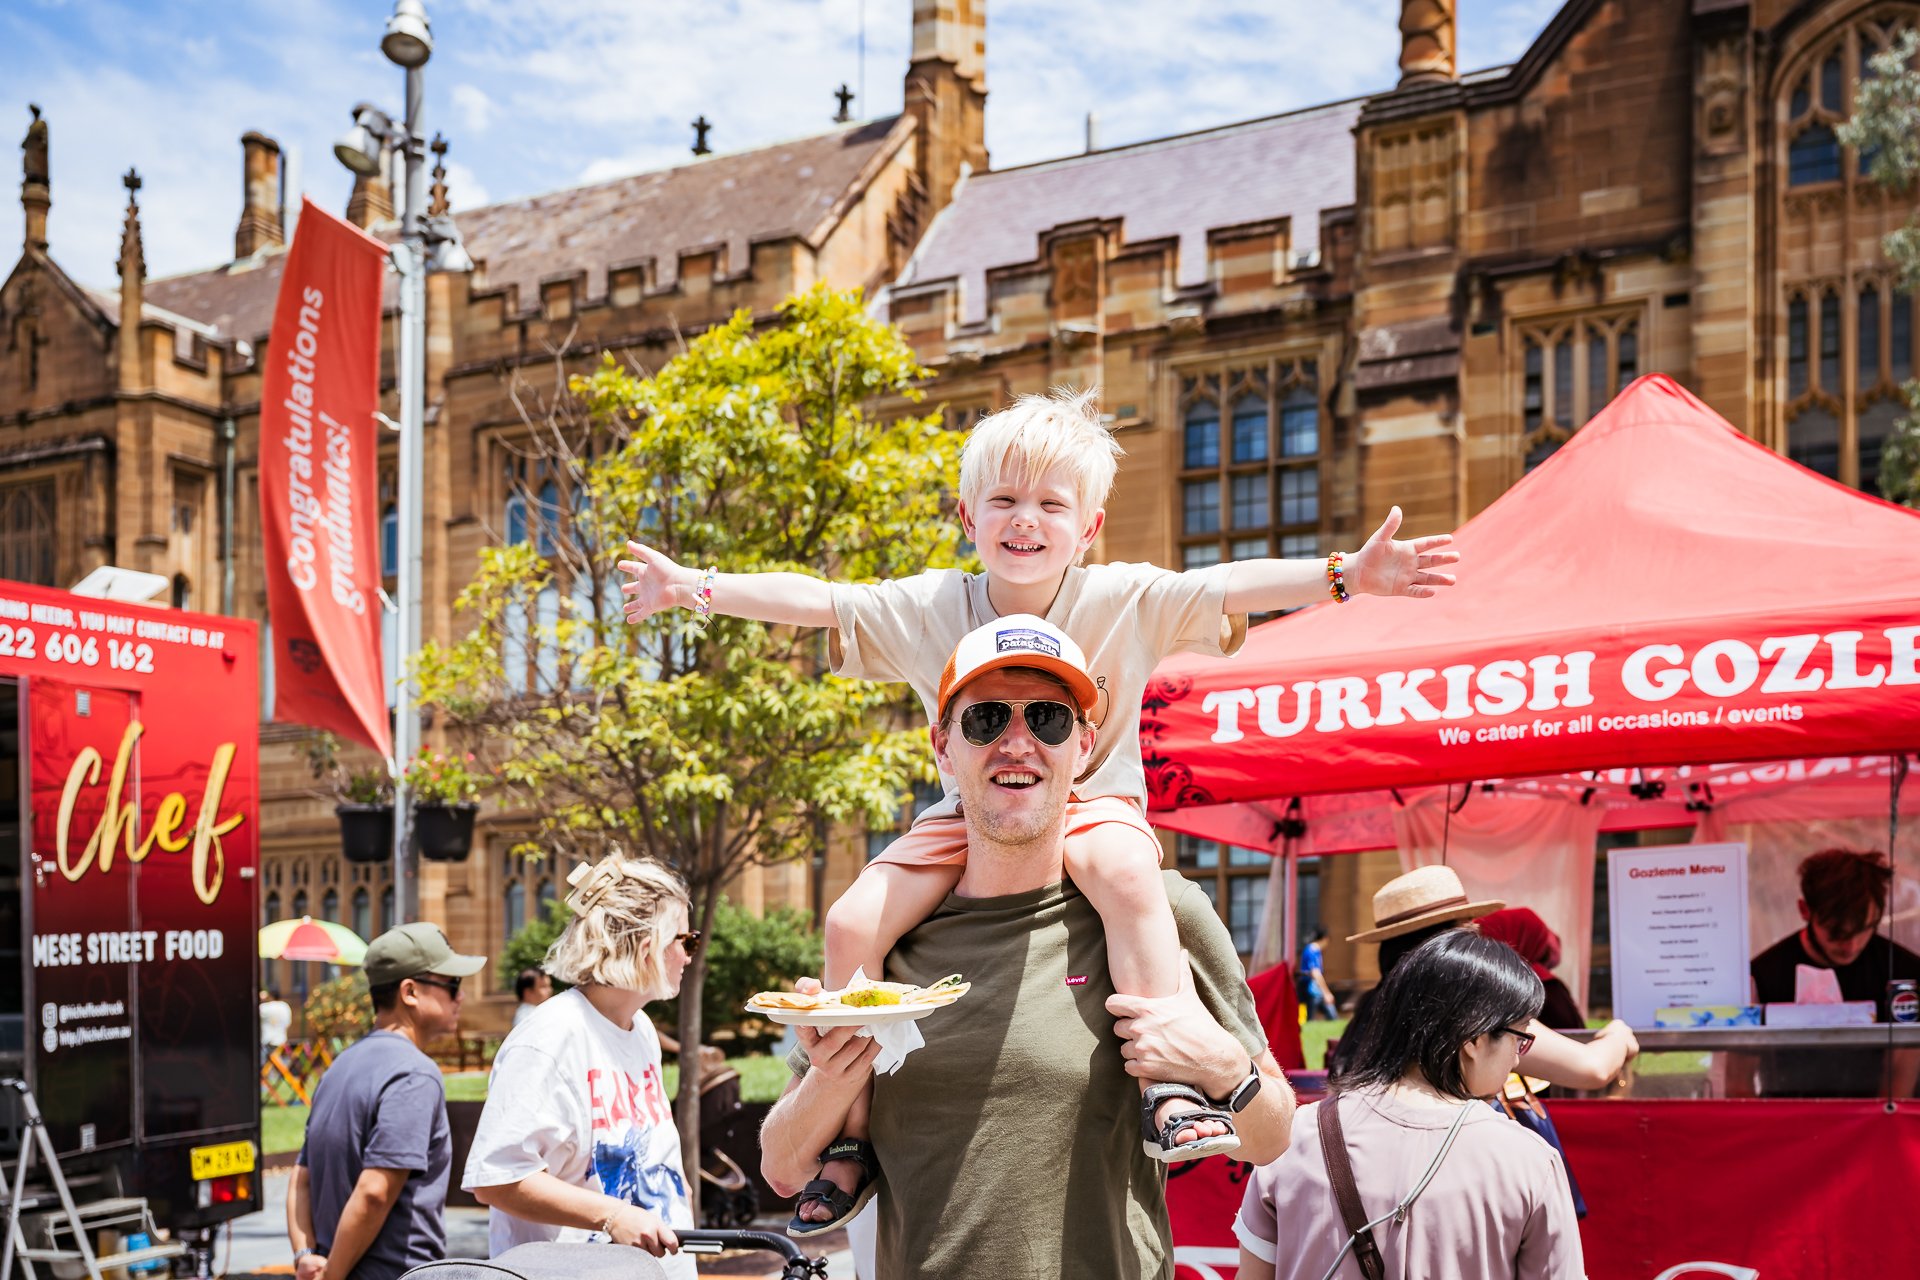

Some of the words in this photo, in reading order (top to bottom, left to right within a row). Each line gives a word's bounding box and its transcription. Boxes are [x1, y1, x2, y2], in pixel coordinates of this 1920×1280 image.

[283, 286, 324, 591] Congratulations
[318, 411, 366, 616] graduates!
[0, 623, 36, 659] 22
[45, 631, 99, 666] 606
[107, 639, 154, 673] 162
[79, 611, 105, 631] YOU
[106, 615, 135, 635] MAY
[136, 619, 190, 644] CONTACT
[190, 628, 208, 647] US
[208, 631, 225, 649] AT
[1201, 651, 1596, 744] TURKISH
[1439, 728, 1470, 746] We
[1476, 723, 1528, 742] cater
[1532, 718, 1562, 737] for
[1567, 715, 1593, 733] all
[1598, 708, 1710, 731] occasions
[1728, 702, 1804, 724] events
[57, 719, 246, 904] Chef
[1629, 866, 1686, 879] Gozleme
[1690, 864, 1726, 875] Menu
[87, 931, 158, 963] STREET
[165, 929, 224, 961] FOOD
